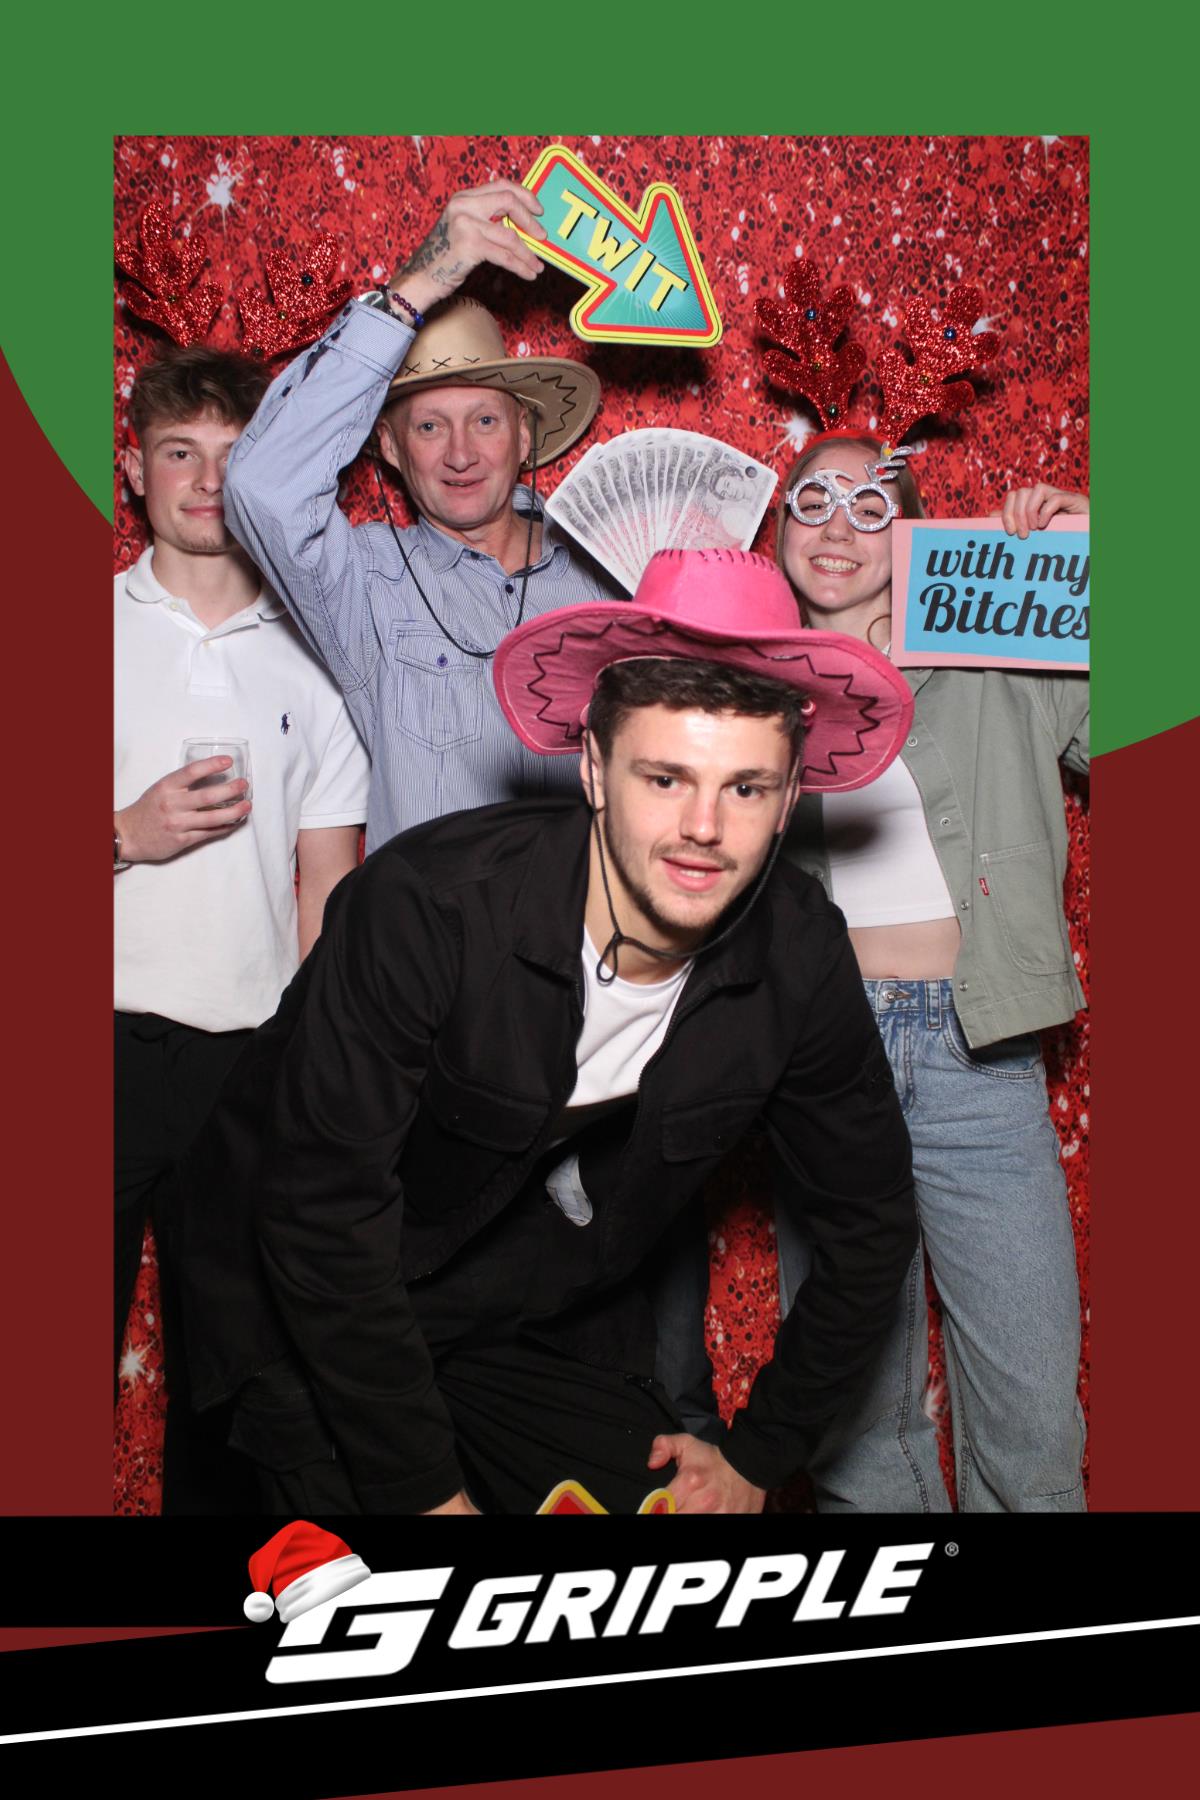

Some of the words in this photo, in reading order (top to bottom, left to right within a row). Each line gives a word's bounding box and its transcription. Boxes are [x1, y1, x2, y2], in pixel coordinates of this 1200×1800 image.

[557, 188, 689, 312] TWIT
[925, 540, 1015, 580] with
[1024, 553, 1090, 596] my
[919, 582, 1090, 641] Bitches
